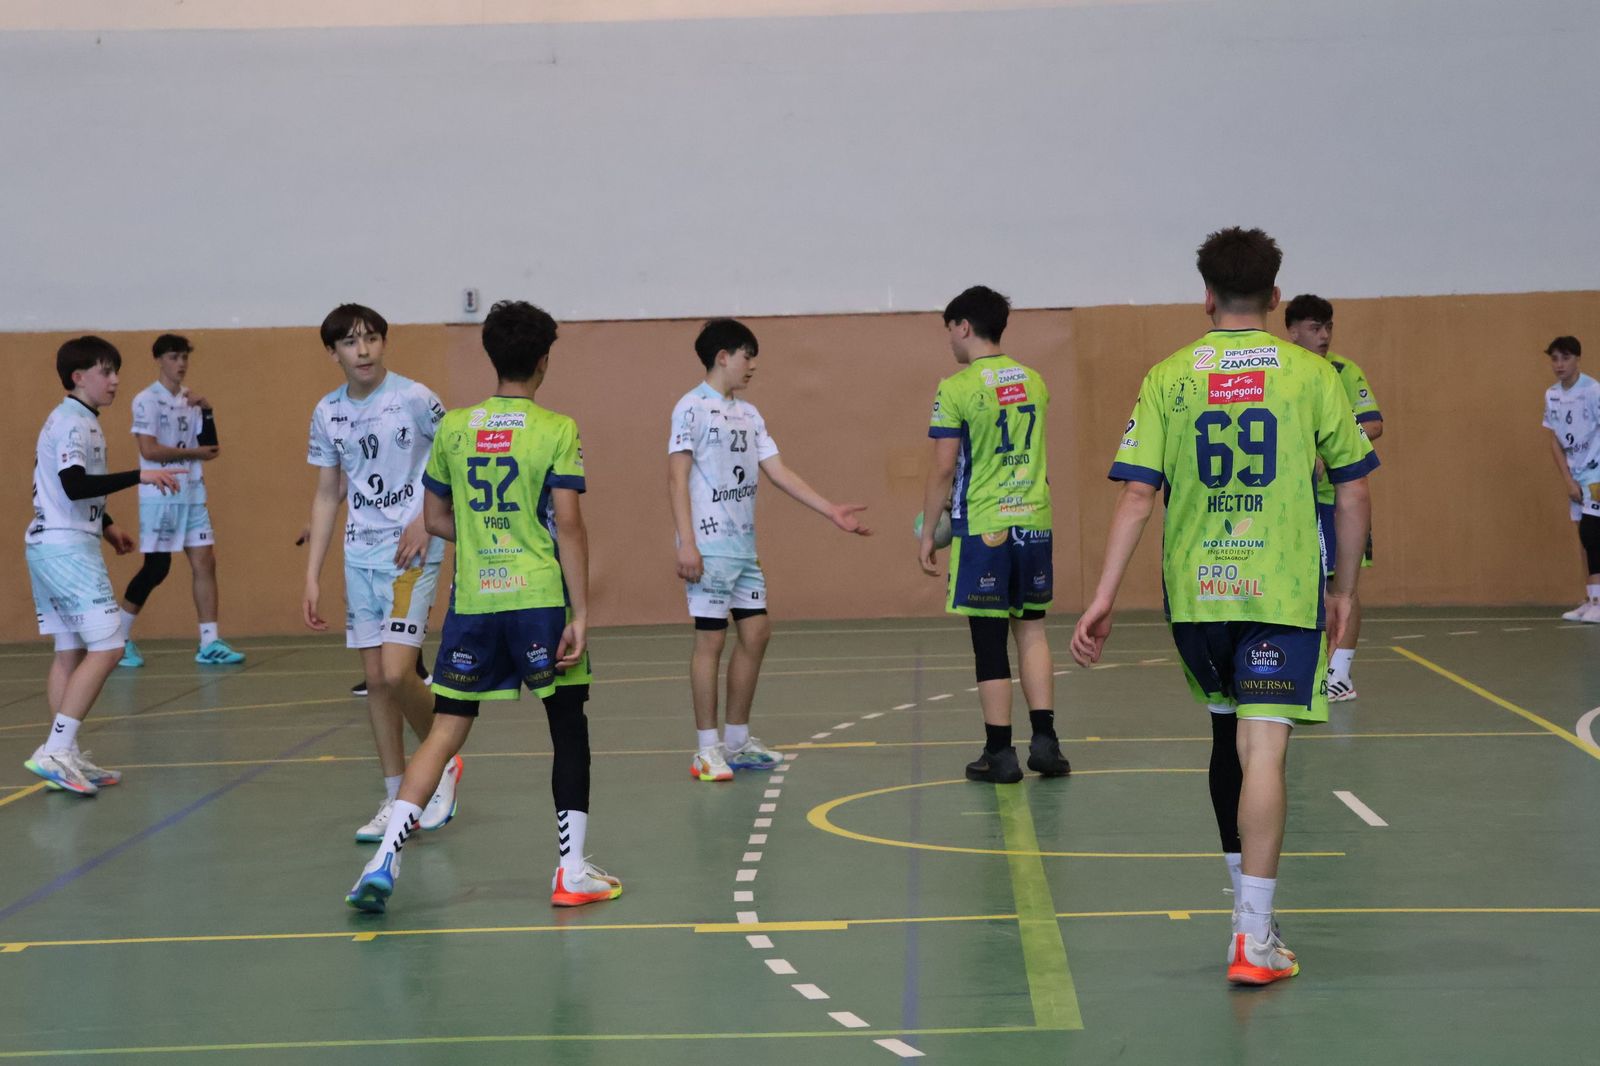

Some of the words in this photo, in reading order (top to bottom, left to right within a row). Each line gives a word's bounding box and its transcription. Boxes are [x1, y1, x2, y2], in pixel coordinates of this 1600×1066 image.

[1220, 357, 1279, 370] ZAMORA
[1209, 386, 1263, 399] sangregorio
[177, 415, 189, 431] 15
[487, 420, 524, 428] ZAMORA
[1565, 410, 1573, 425] 6
[995, 404, 1036, 454] 17
[358, 433, 379, 460] 19
[730, 429, 748, 453] 23
[1194, 408, 1278, 489] 69
[467, 456, 520, 512] 52
[1207, 490, 1263, 513] HÉCTOR
[483, 516, 511, 530] YAGO
[479, 567, 508, 579] PRO
[1198, 565, 1238, 580] PRO
[1251, 649, 1279, 658] Estrella
[1251, 658, 1278, 666] Galicia
[1239, 680, 1295, 691] UNIVERSAL
